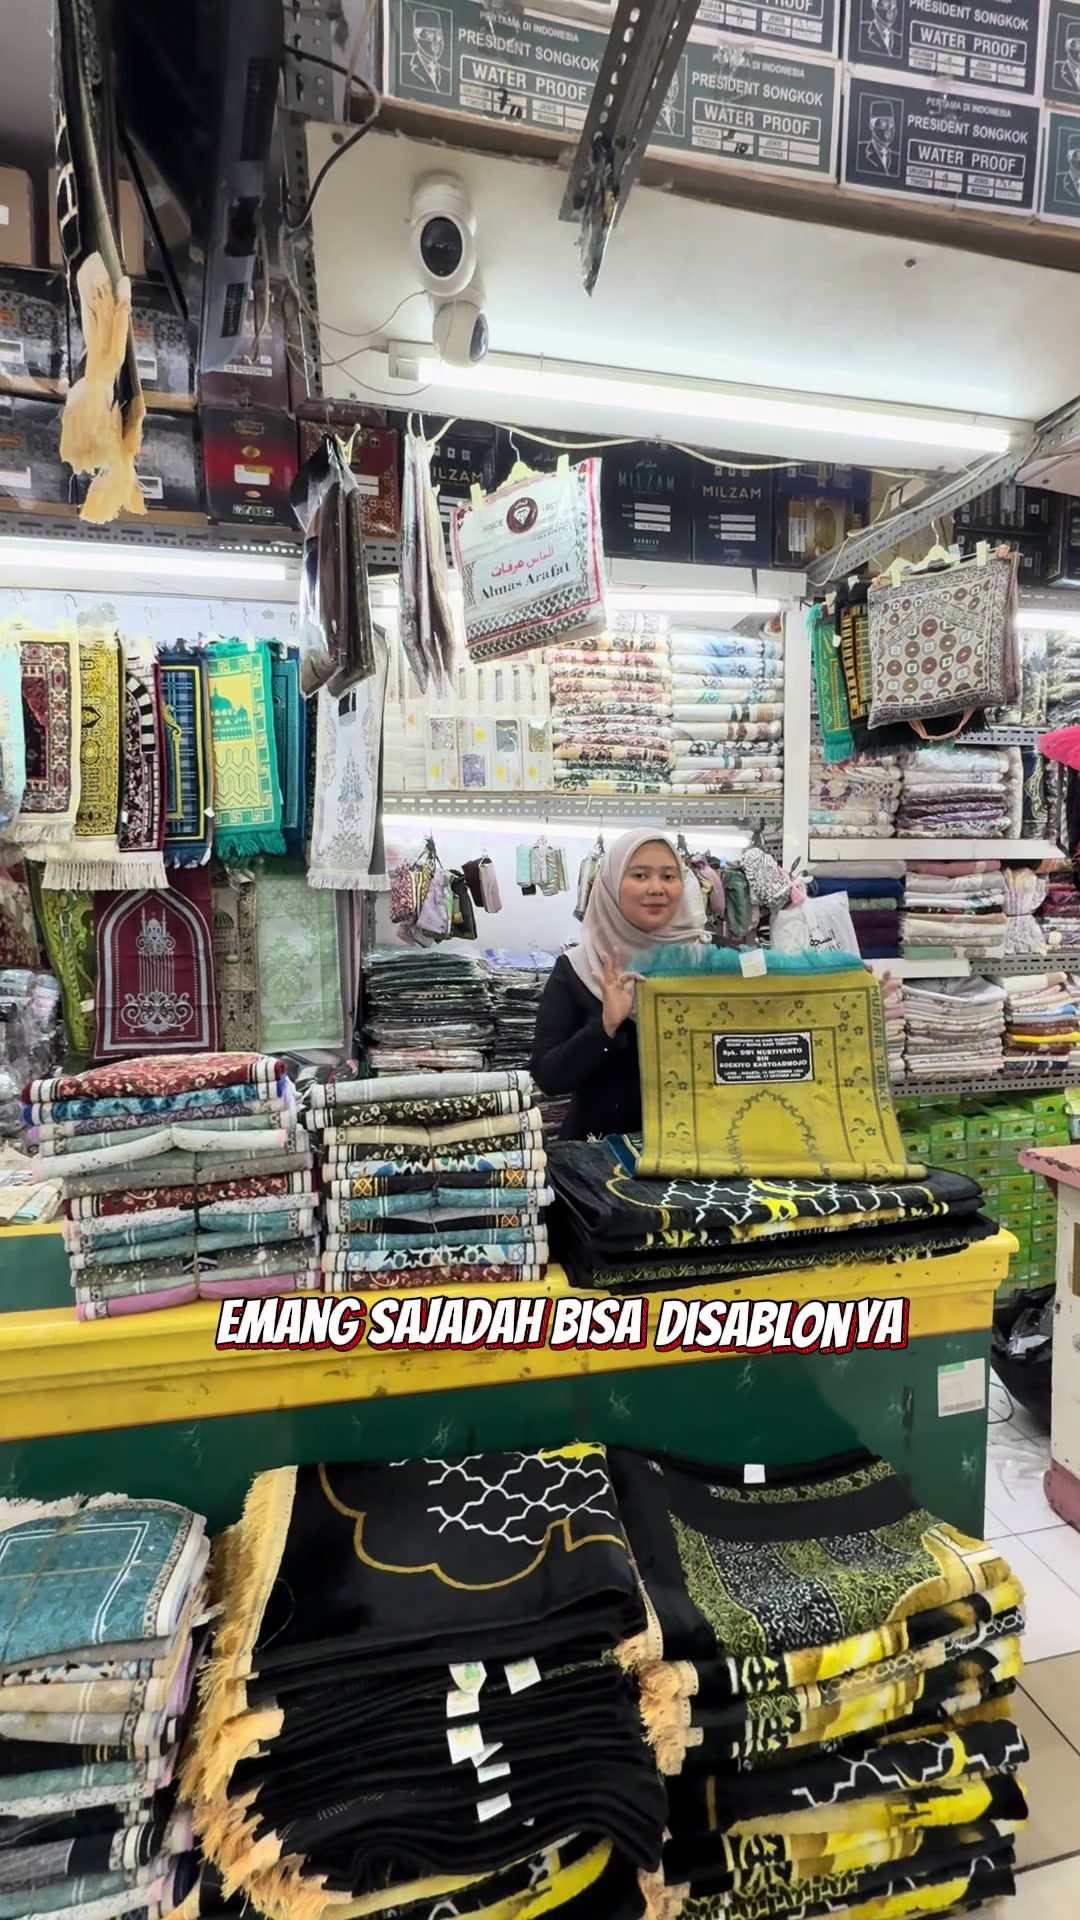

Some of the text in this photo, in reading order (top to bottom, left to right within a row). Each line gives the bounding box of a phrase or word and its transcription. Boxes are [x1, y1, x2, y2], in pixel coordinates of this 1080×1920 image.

[909, 0, 1029, 31] PRESIDENT SONGKOK
[523, 21, 532, 32] DI
[533, 24, 579, 43] INDONESIA
[920, 27, 1018, 59] WATER PROOF
[458, 28, 600, 73] PRESIDENT SONGKOK
[472, 62, 587, 101] WATER PROOF
[762, 63, 805, 79] INDONESIA
[692, 71, 823, 107] PRESIDENT SONGKOK
[704, 104, 811, 136] WATER PROOF
[926, 97, 1011, 119] PERTAMA DI INDONESIA
[907, 114, 1028, 144] PRESIDENT SONGKOK
[918, 145, 1016, 173] WATER PROOF
[433, 467, 483, 483] ILZAM
[618, 471, 675, 491] MILZAM
[703, 485, 761, 499] MILZAM
[480, 562, 570, 600] Almas Arafat
[870, 985, 892, 1115] MUSAFIR TURKEY
